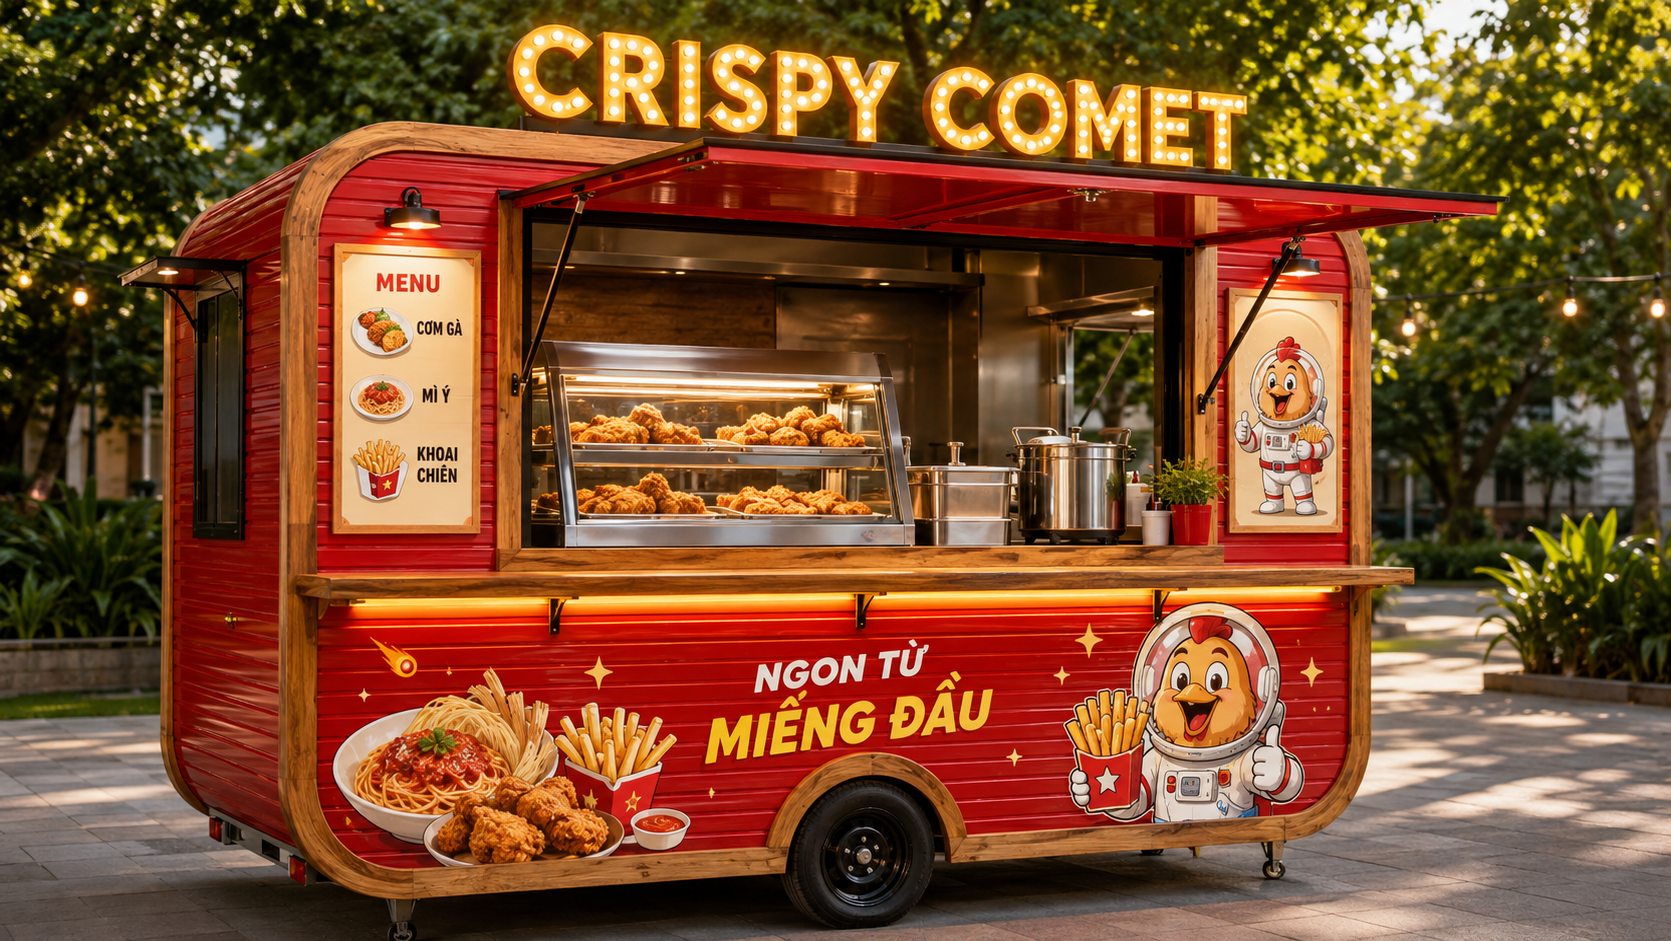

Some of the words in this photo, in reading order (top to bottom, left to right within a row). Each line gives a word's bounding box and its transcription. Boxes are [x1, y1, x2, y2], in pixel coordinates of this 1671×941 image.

[507, 24, 900, 143] CRISPY
[925, 66, 1248, 171] COMET
[376, 273, 440, 293] MENU
[416, 319, 443, 336] CƠM
[446, 319, 463, 336] GÀ
[422, 385, 438, 403] MÌ
[442, 384, 451, 403] Ý
[417, 446, 458, 462] KHOAI
[417, 464, 458, 483] CHIÊN
[754, 653, 867, 693] NGON
[878, 639, 929, 679] TỪ
[704, 690, 876, 765] MIẾNG
[888, 671, 993, 740] ĐẦU
